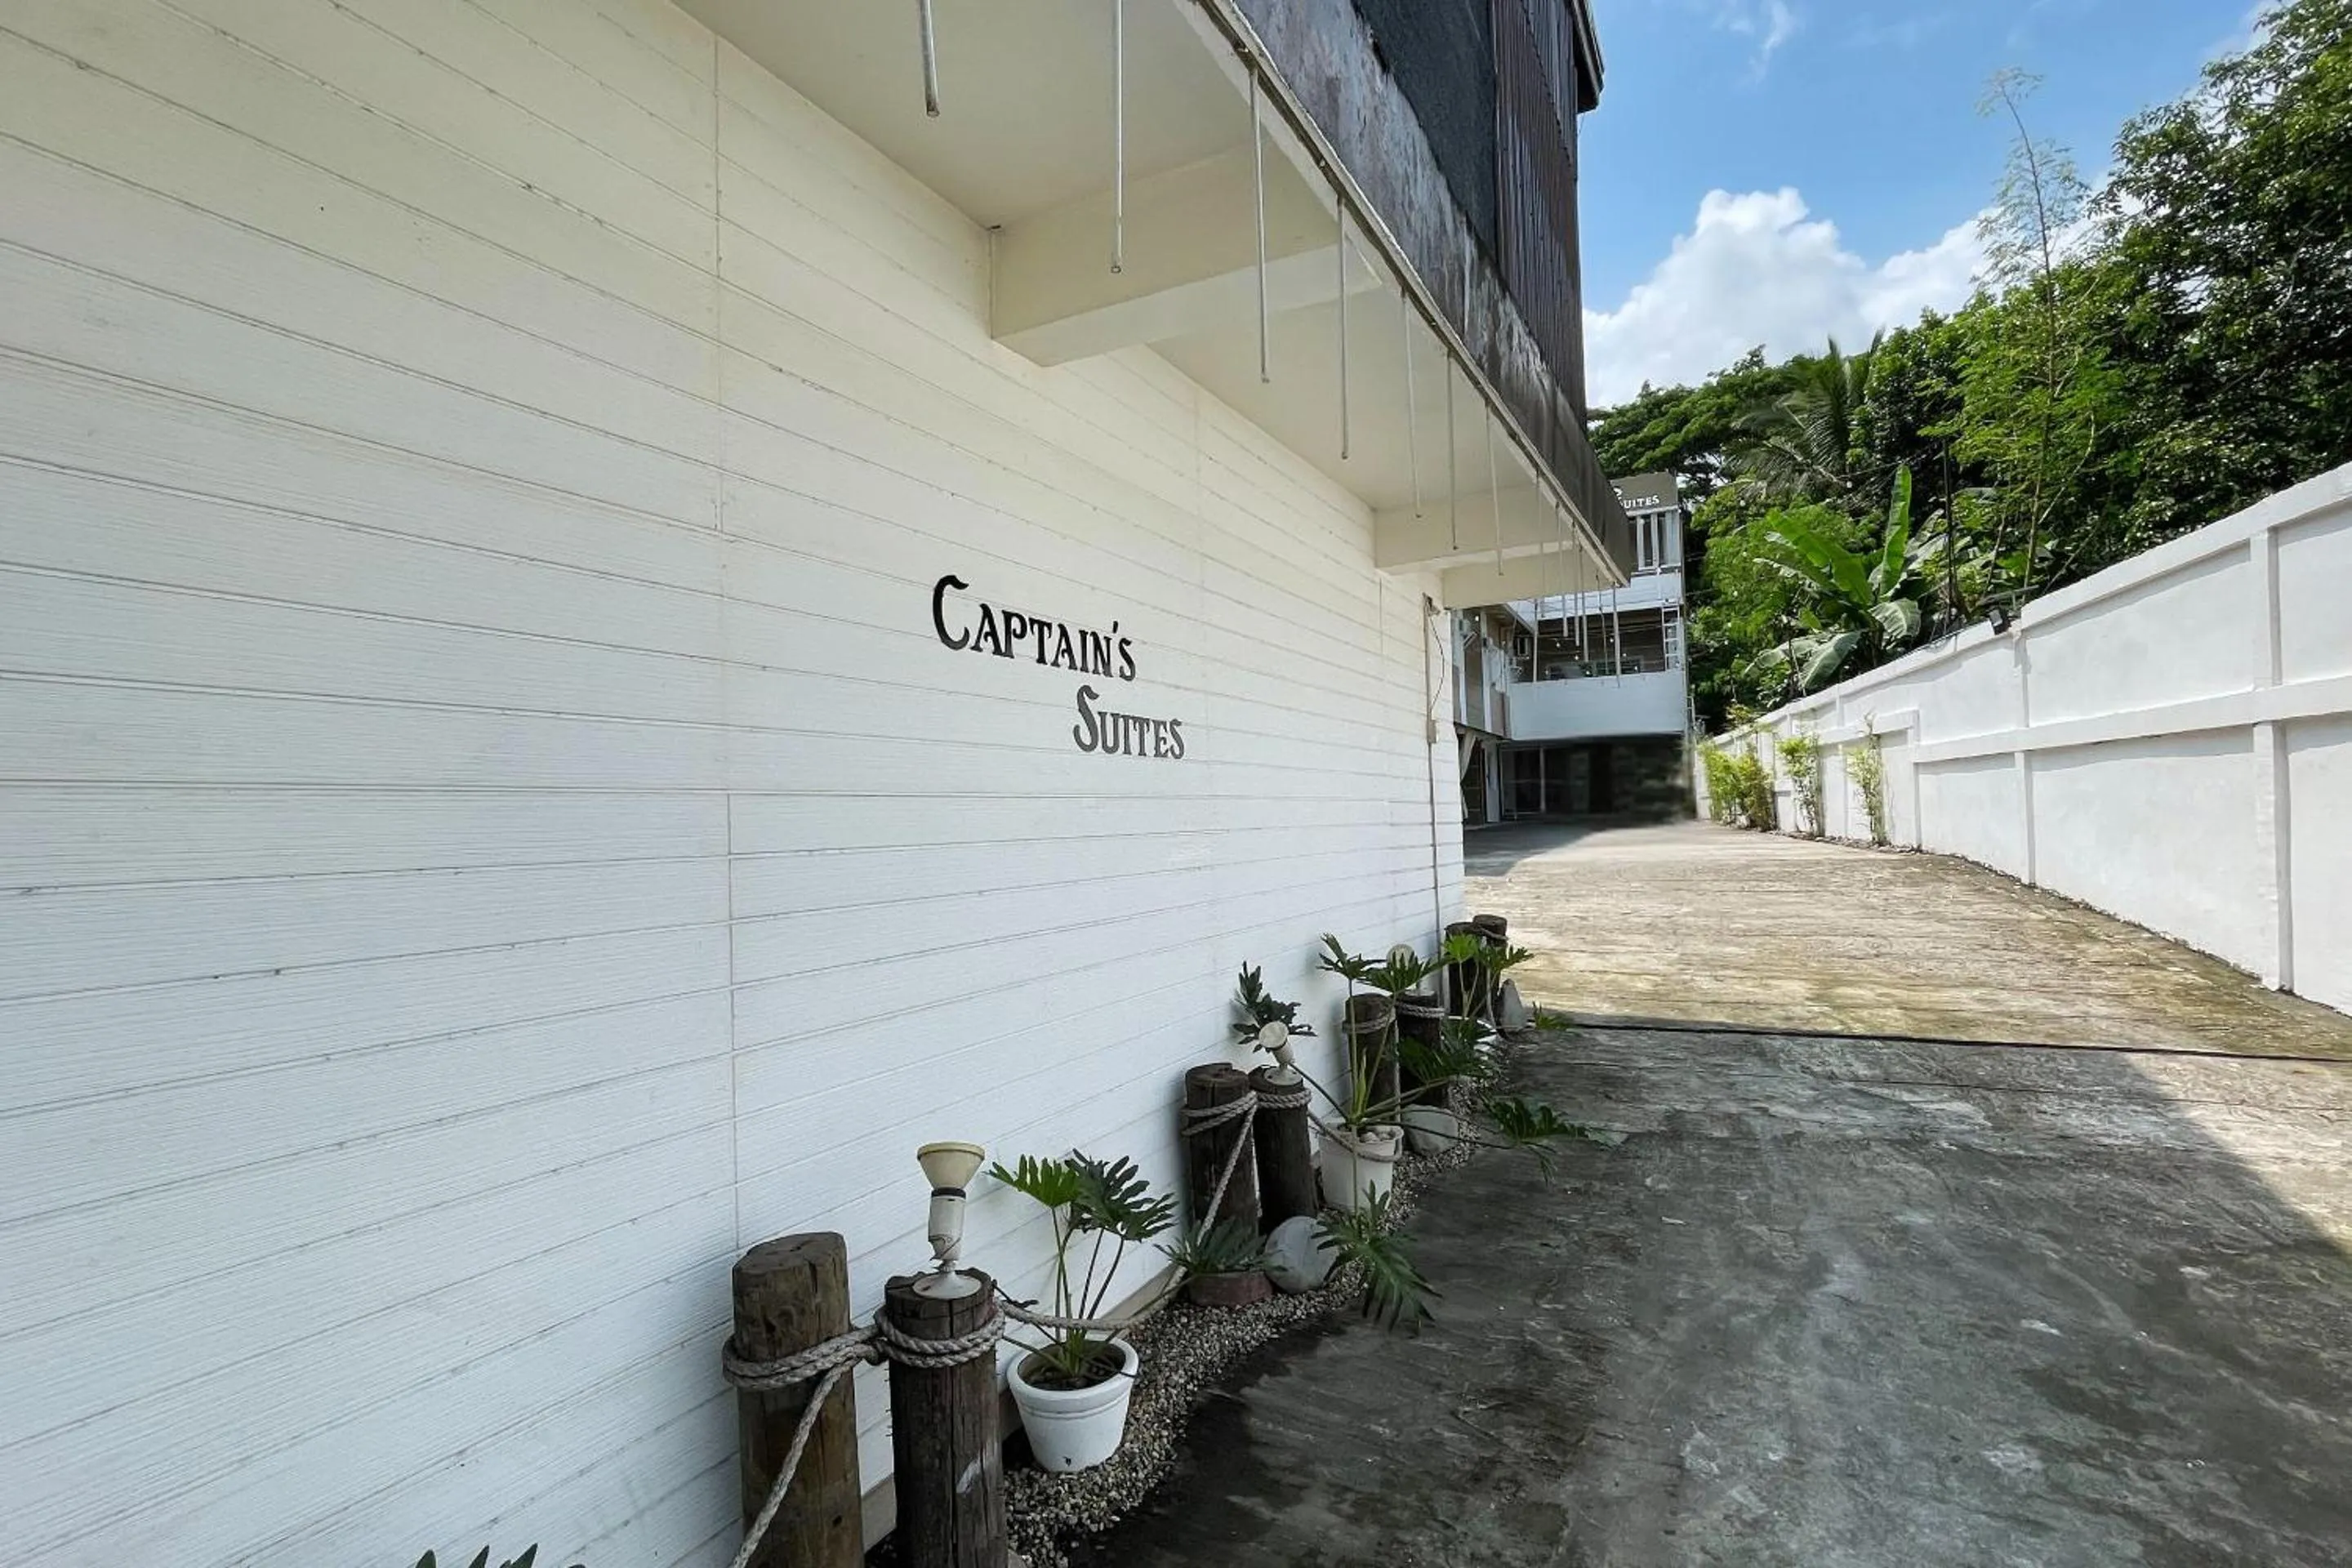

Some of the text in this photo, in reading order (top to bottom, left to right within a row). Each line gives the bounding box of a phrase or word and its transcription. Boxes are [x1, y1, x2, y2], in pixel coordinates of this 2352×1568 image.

[1618, 495, 1660, 509] UITES
[933, 575, 1136, 681] CAPTAIN'S
[1073, 684, 1185, 760] SUITES
